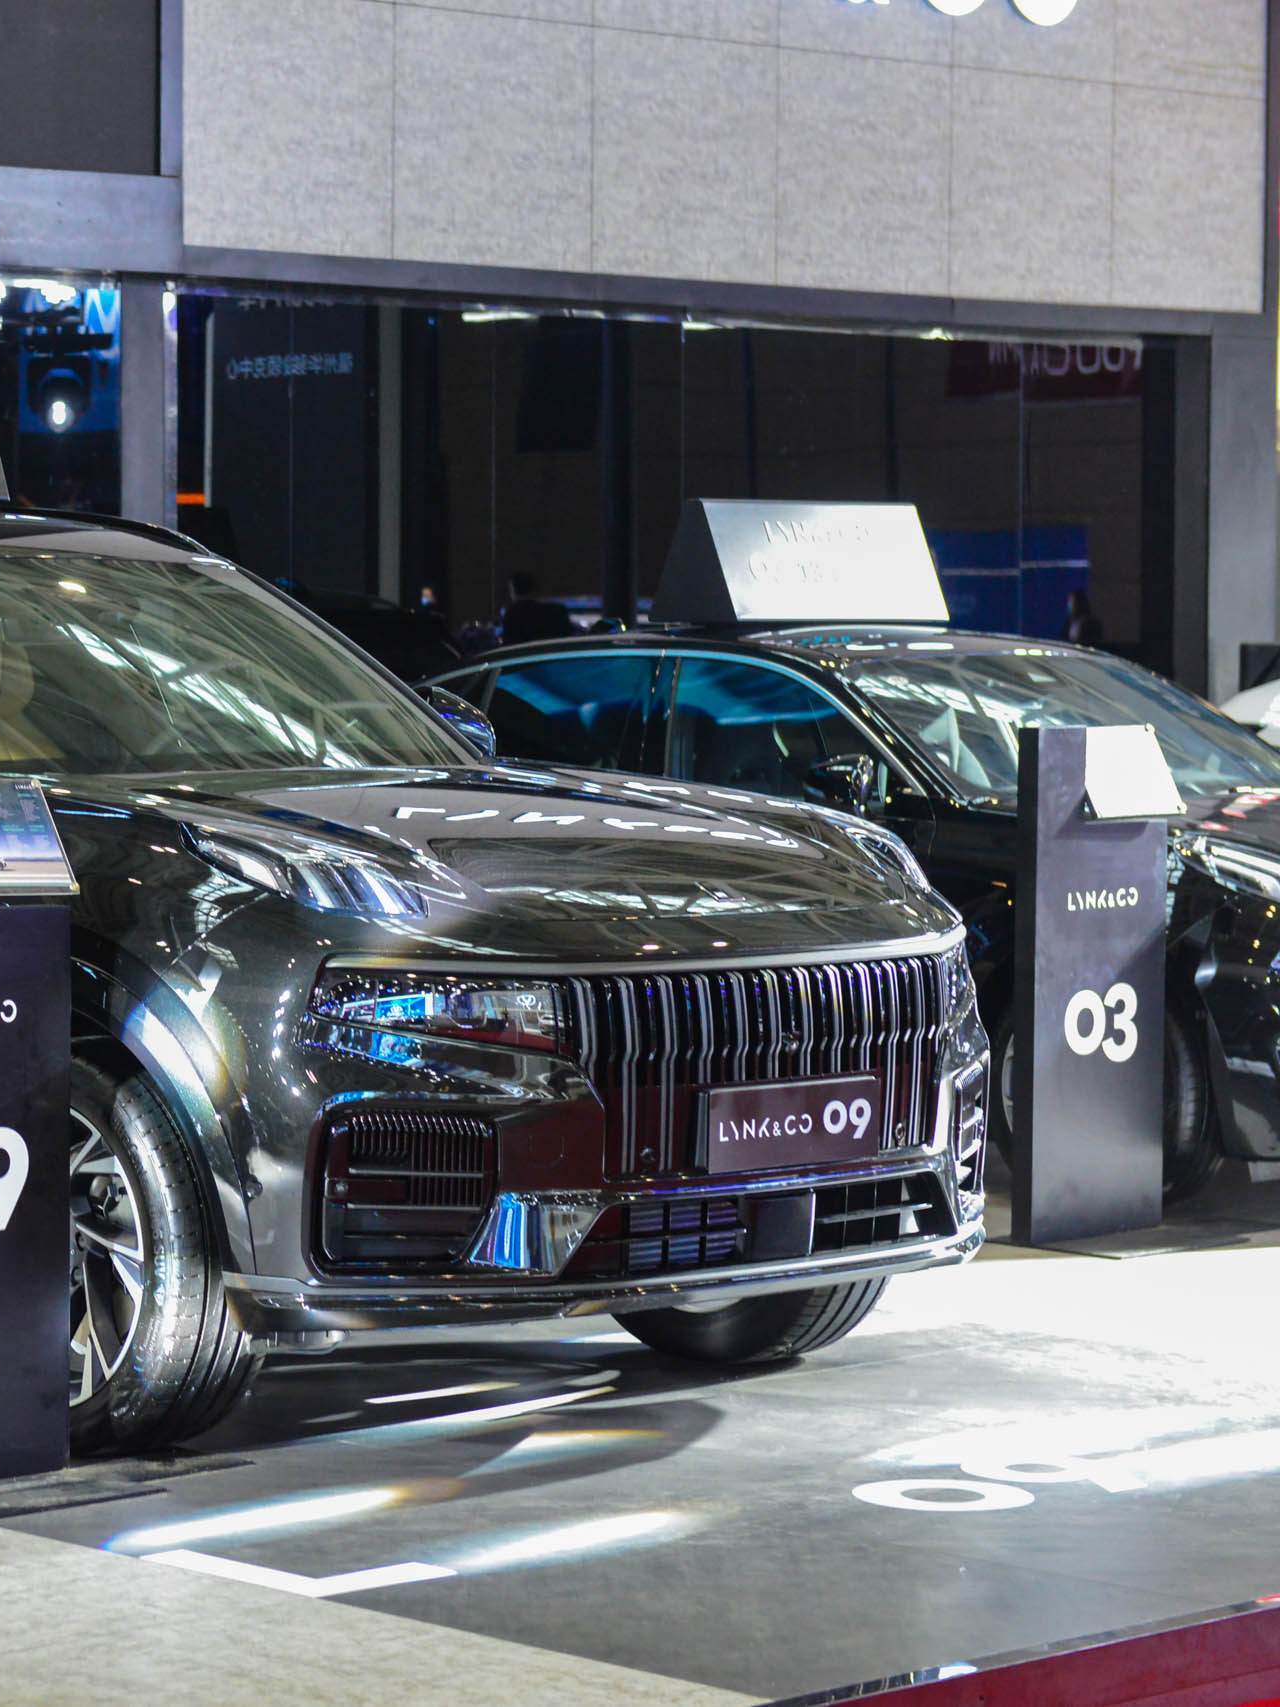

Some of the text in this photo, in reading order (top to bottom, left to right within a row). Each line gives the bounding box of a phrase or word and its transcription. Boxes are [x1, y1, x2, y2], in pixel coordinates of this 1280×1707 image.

[1067, 887, 1139, 912] LYNK&CO
[1064, 982, 1138, 1063] 03
[720, 1098, 872, 1142] LYNK&CO 09
